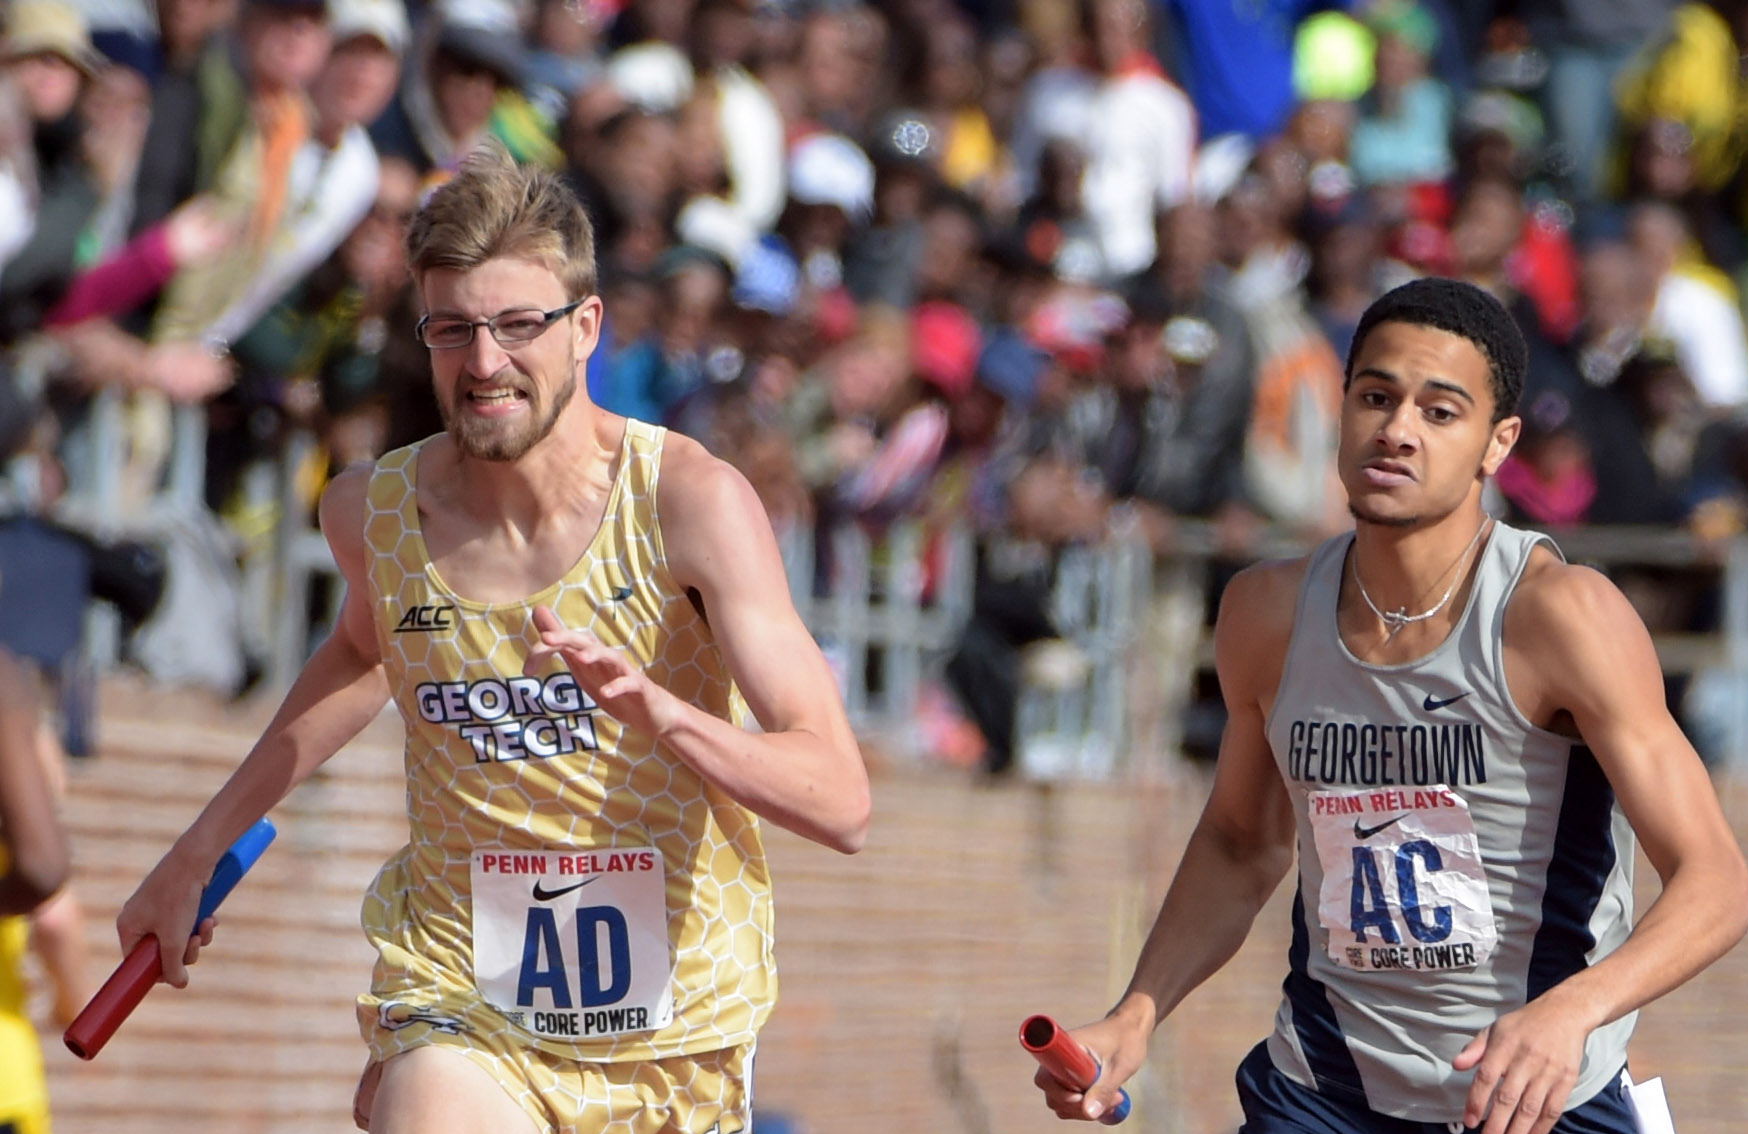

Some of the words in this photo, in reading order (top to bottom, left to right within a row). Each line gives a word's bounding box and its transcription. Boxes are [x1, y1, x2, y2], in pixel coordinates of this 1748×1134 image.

[396, 605, 455, 629] ACC
[460, 715, 600, 763] TECH
[1288, 720, 1487, 786] GEORGETOWN
[1316, 794, 1363, 815] PENN
[1370, 790, 1456, 812] RELAYS
[482, 855, 548, 875] PENN
[558, 852, 655, 874] RELAYS
[1350, 840, 1453, 944] AC
[516, 905, 633, 1009] AD
[1371, 947, 1410, 969] CORE
[1413, 943, 1476, 969] POWER
[534, 1011, 579, 1036] CORE
[584, 1007, 648, 1034] POWER
